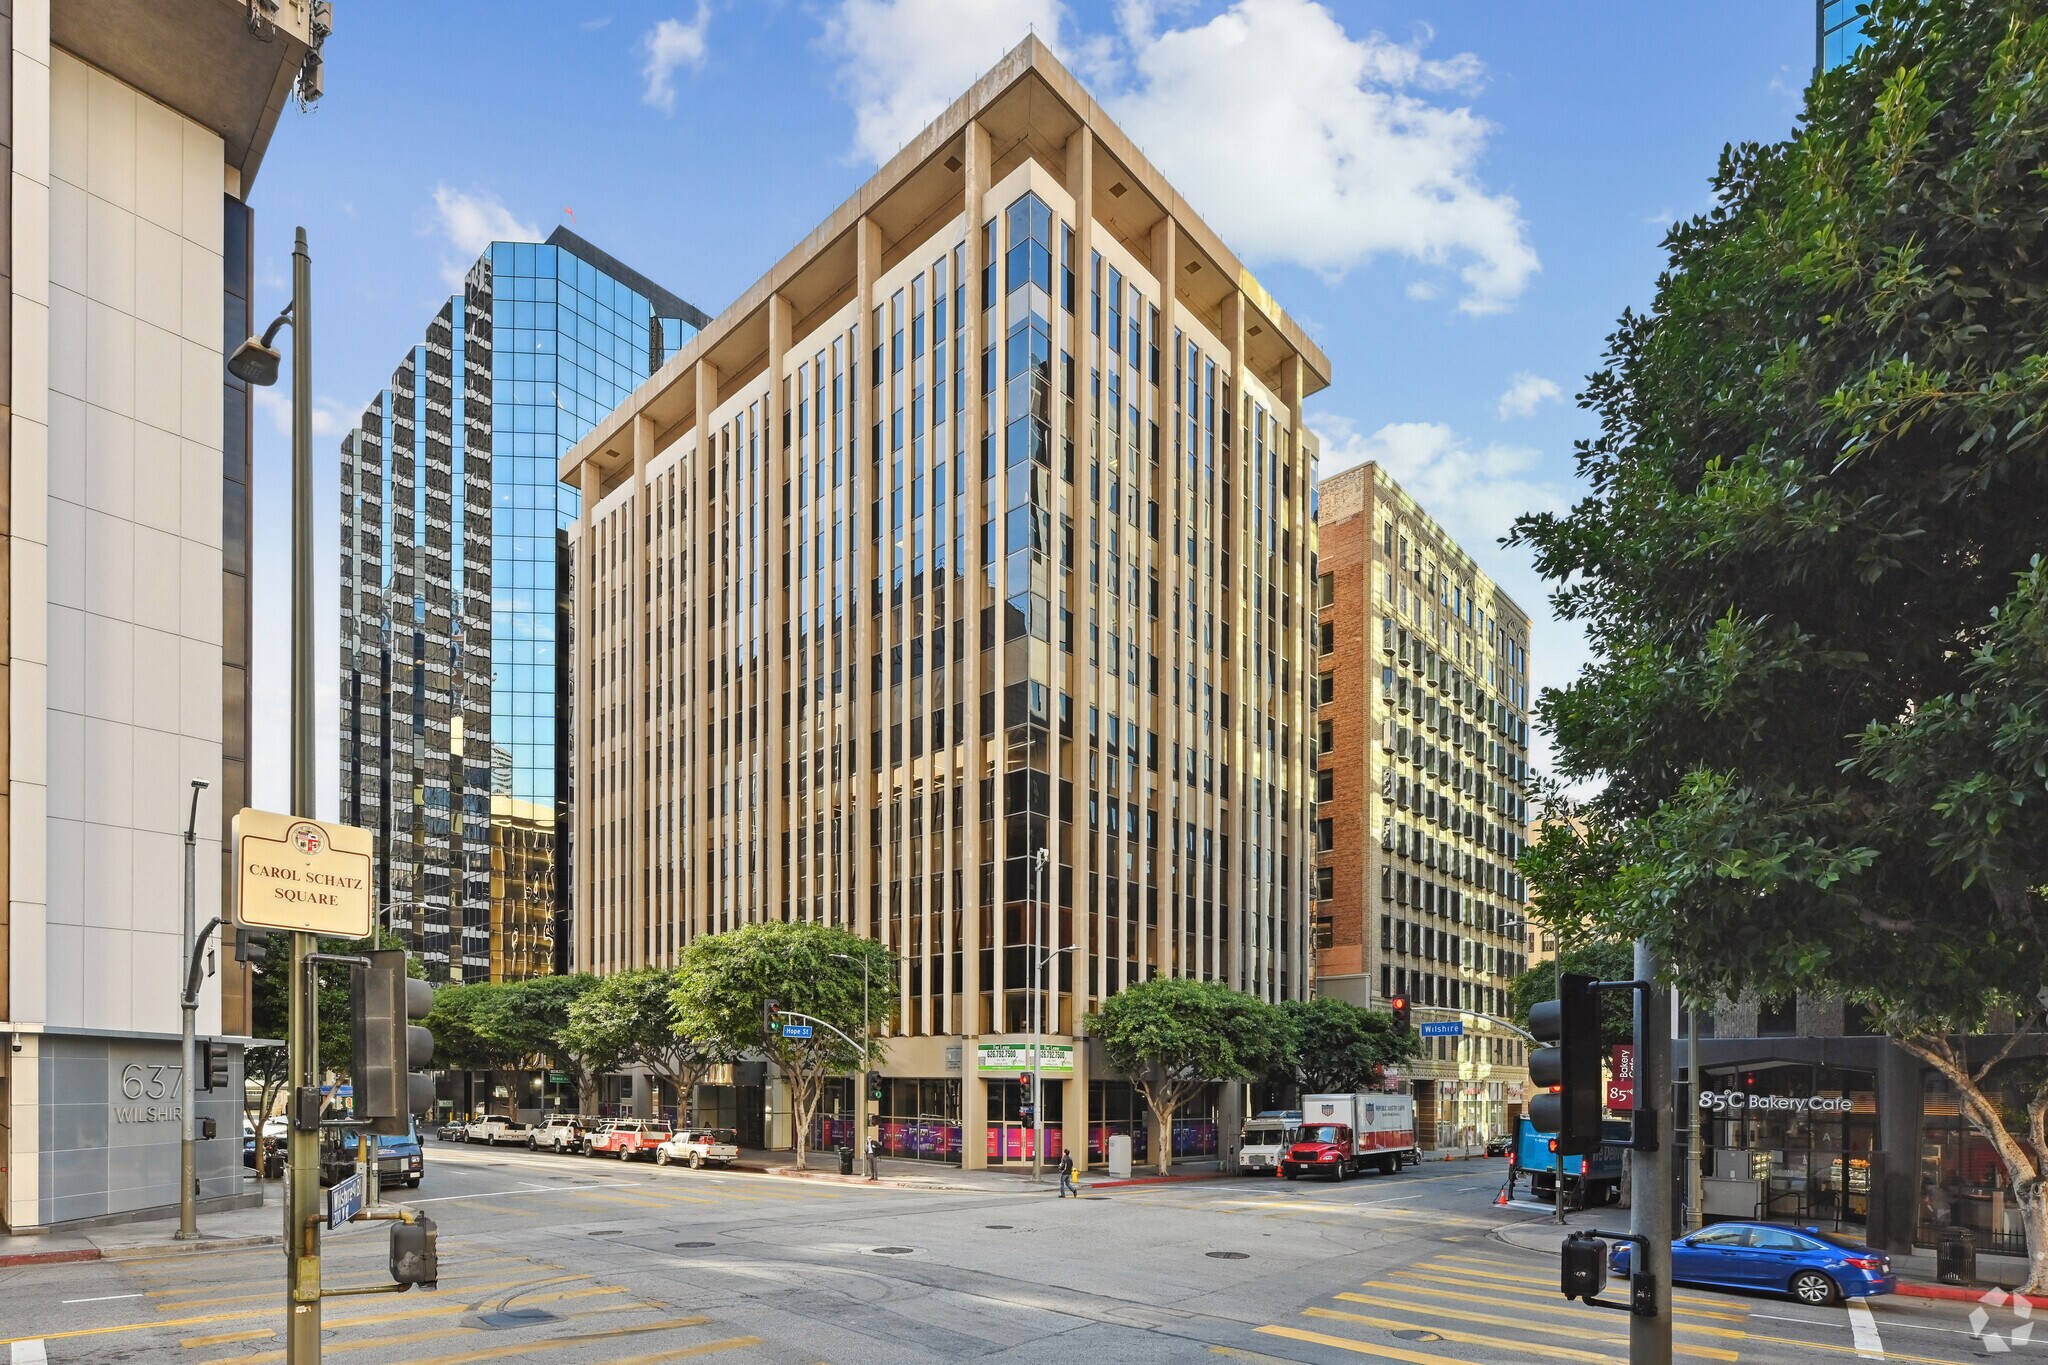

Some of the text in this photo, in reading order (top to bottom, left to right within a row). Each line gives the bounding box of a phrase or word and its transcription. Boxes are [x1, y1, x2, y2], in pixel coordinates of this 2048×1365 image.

[249, 863, 363, 890] CAROL SCHATZ
[274, 887, 340, 906] SQUARE
[1424, 1025, 1459, 1033] Wilshire
[1040, 1051, 1065, 1059] 26.792.7500
[1620, 1049, 1630, 1078] Bakery
[121, 1063, 183, 1099] 637
[1749, 1094, 1806, 1113] Bakery
[1808, 1096, 1854, 1111] Cafe
[115, 1106, 183, 1123] WILSHIR
